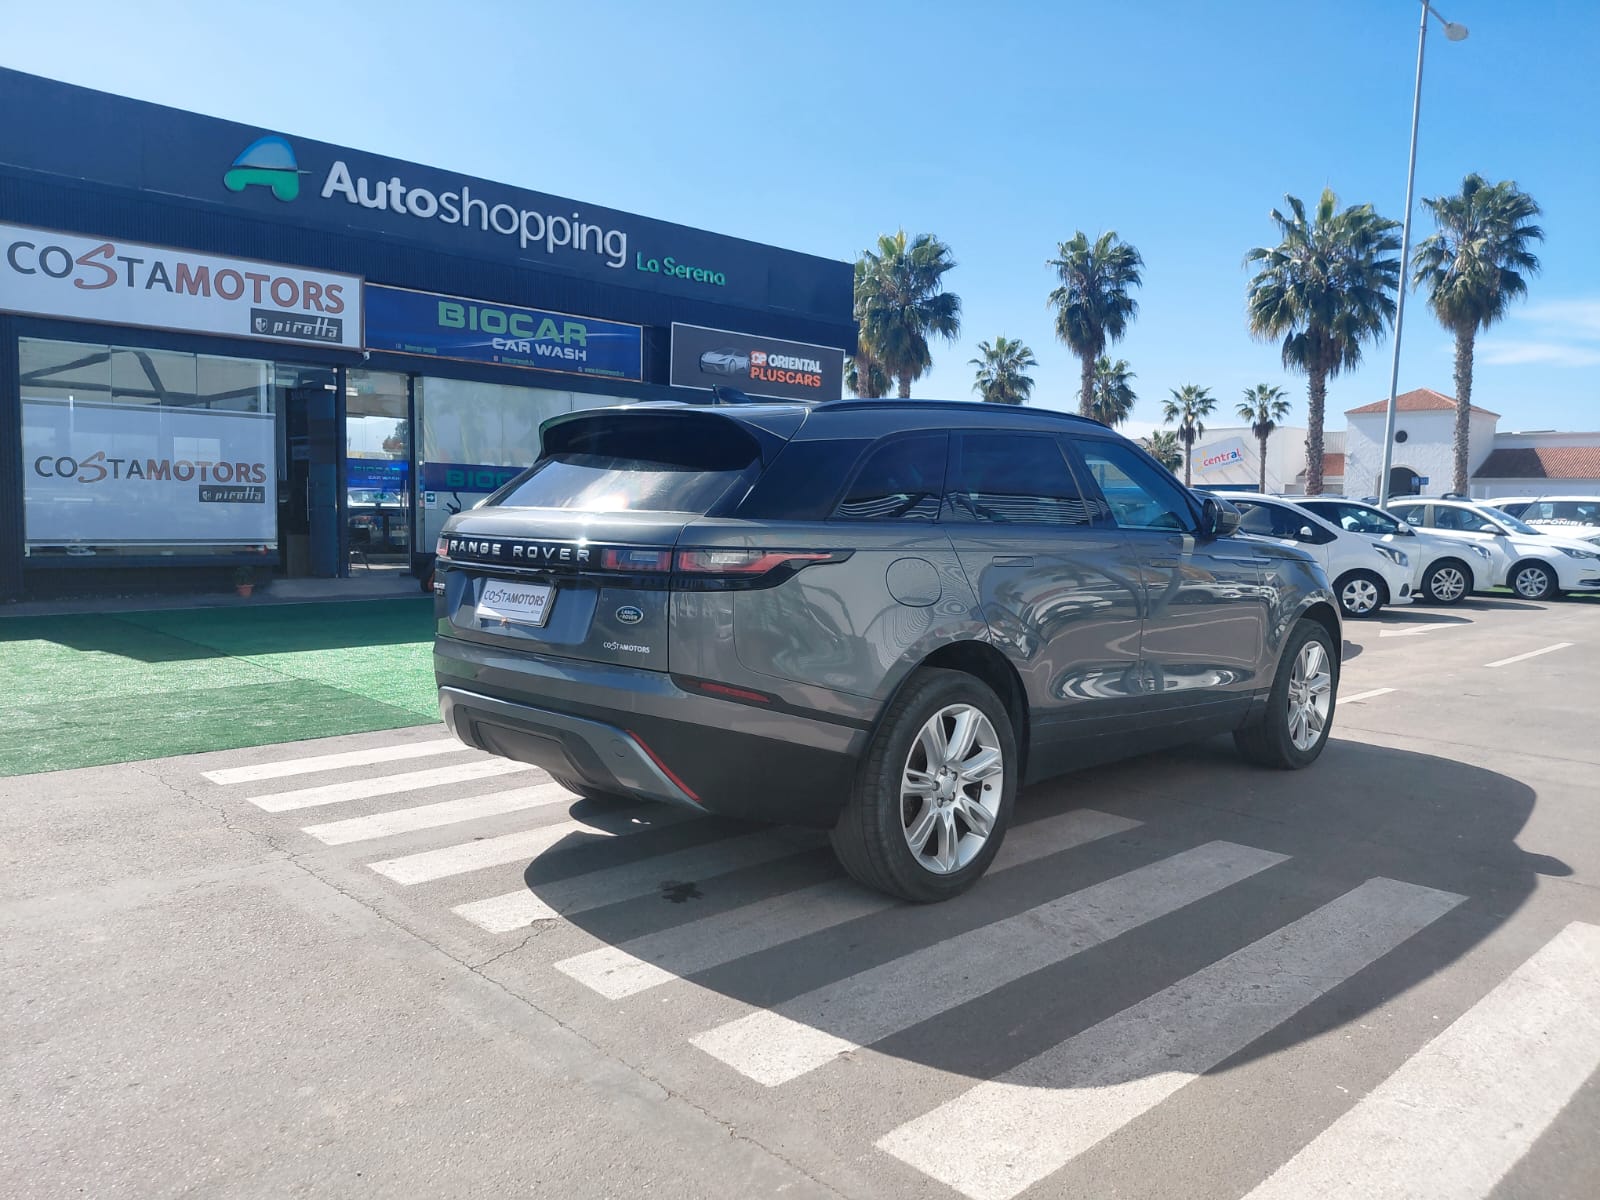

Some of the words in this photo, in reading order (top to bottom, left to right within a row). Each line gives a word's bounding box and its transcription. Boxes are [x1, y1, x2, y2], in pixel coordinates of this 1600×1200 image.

[321, 161, 627, 268] Autoshopping
[7, 241, 344, 313] COSTAMOTORS
[636, 251, 658, 273] La
[663, 256, 726, 287] Serena
[272, 318, 338, 338] piretta
[438, 301, 587, 346] BIOCAR
[491, 337, 531, 355] CAR
[534, 343, 587, 362] WASH
[768, 354, 822, 373] ORIENTAL
[751, 367, 821, 387] PLUSCARS
[34, 451, 267, 484] COSTAMOTORS
[1203, 448, 1242, 466] central
[450, 540, 502, 554] RANGE
[512, 546, 590, 561] ROVER
[484, 589, 545, 606] COSTAMOTORS
[603, 641, 650, 653] COSTAMOTORS
